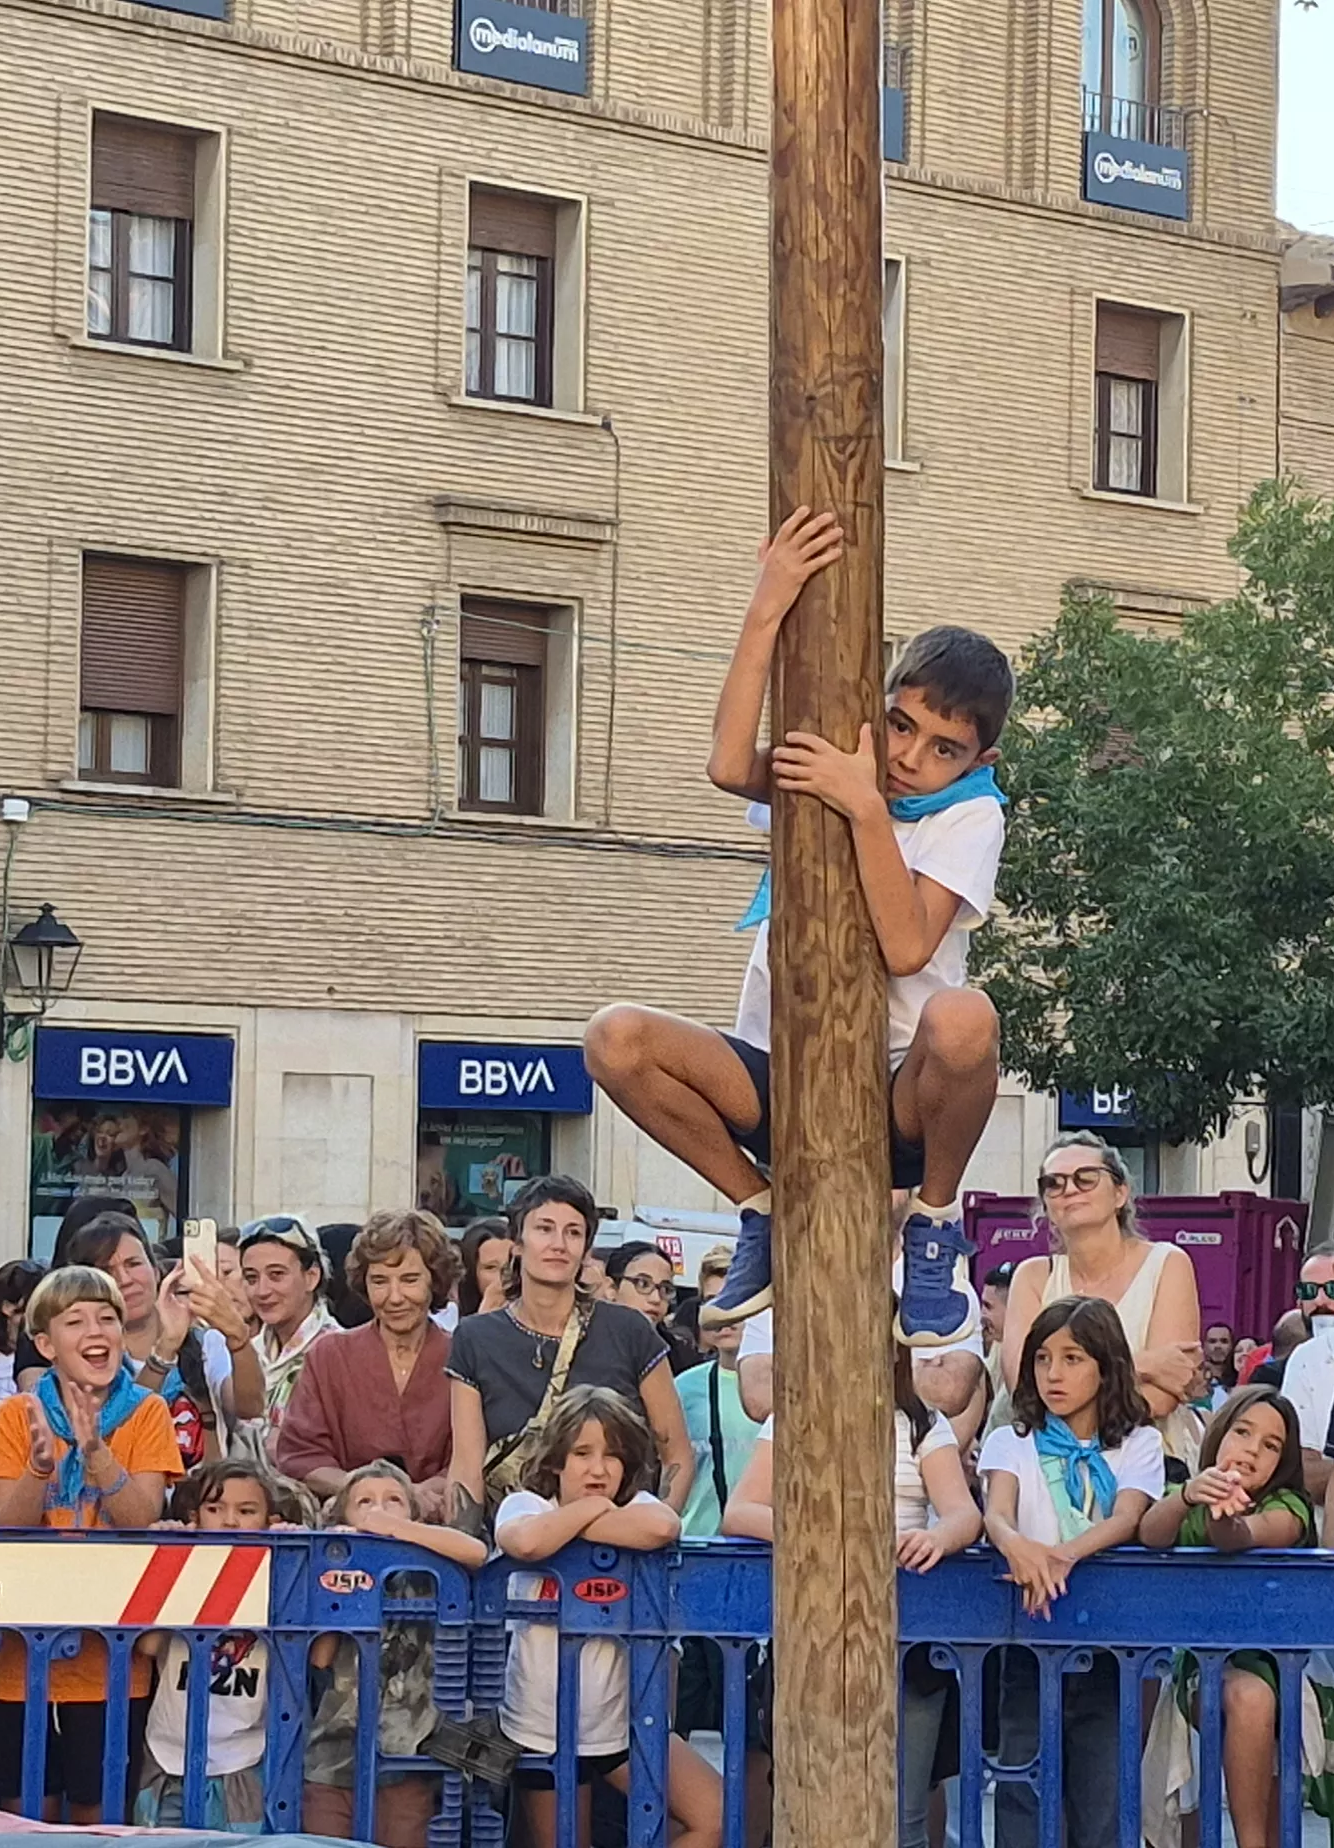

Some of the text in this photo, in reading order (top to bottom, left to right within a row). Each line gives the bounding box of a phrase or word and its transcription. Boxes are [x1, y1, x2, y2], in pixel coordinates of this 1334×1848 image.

[469, 17, 579, 62] mediolanum
[80, 1047, 188, 1086] BBVA
[459, 1057, 556, 1096] BBVA
